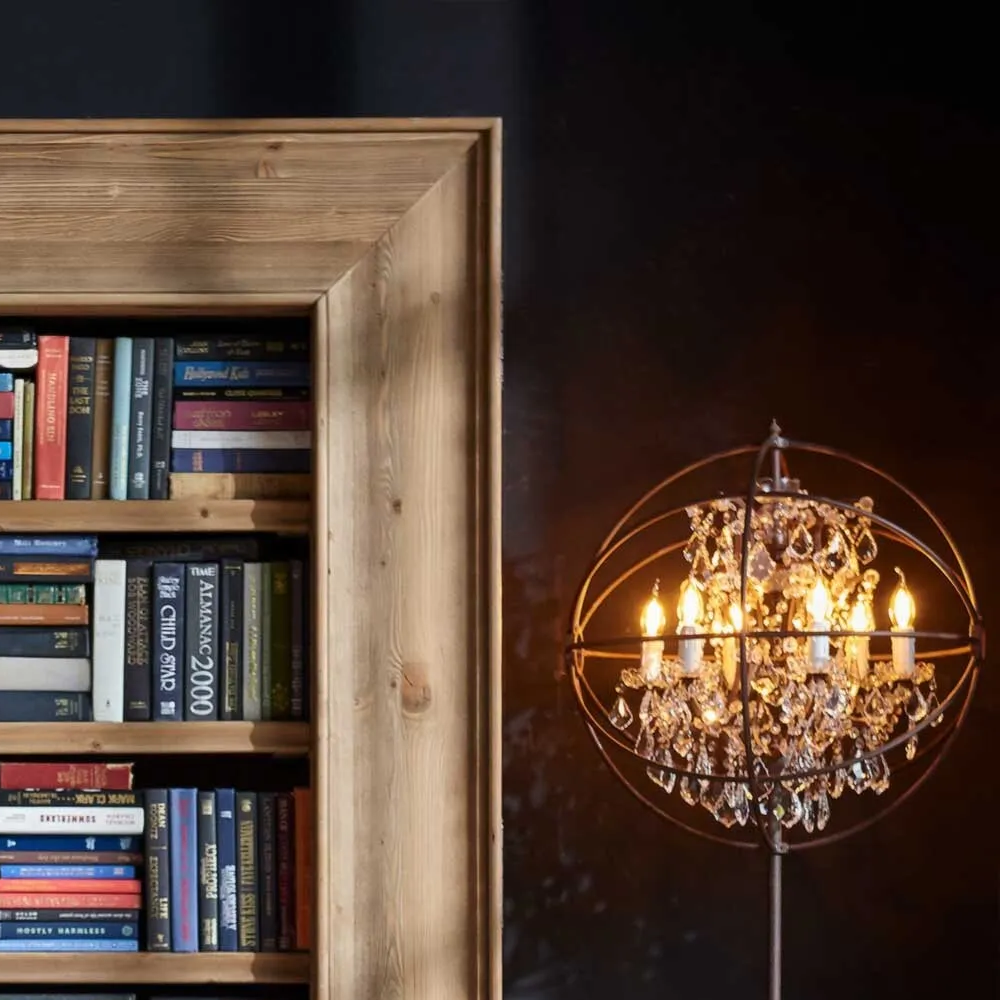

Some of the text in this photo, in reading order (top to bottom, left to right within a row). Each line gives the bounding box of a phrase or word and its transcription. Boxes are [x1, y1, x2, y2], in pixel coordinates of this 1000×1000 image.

[160, 604, 177, 651] CHILD
[190, 566, 216, 716] TIME ALMANAC 2000
[159, 653, 176, 691] STAR
[75, 793, 136, 804] MARK CLARK
[158, 803, 166, 828] DEAN
[204, 843, 218, 899] PROPHECY
[159, 897, 168, 919] LIFE
[16, 927, 106, 935] MOSTLY HARMLESS
